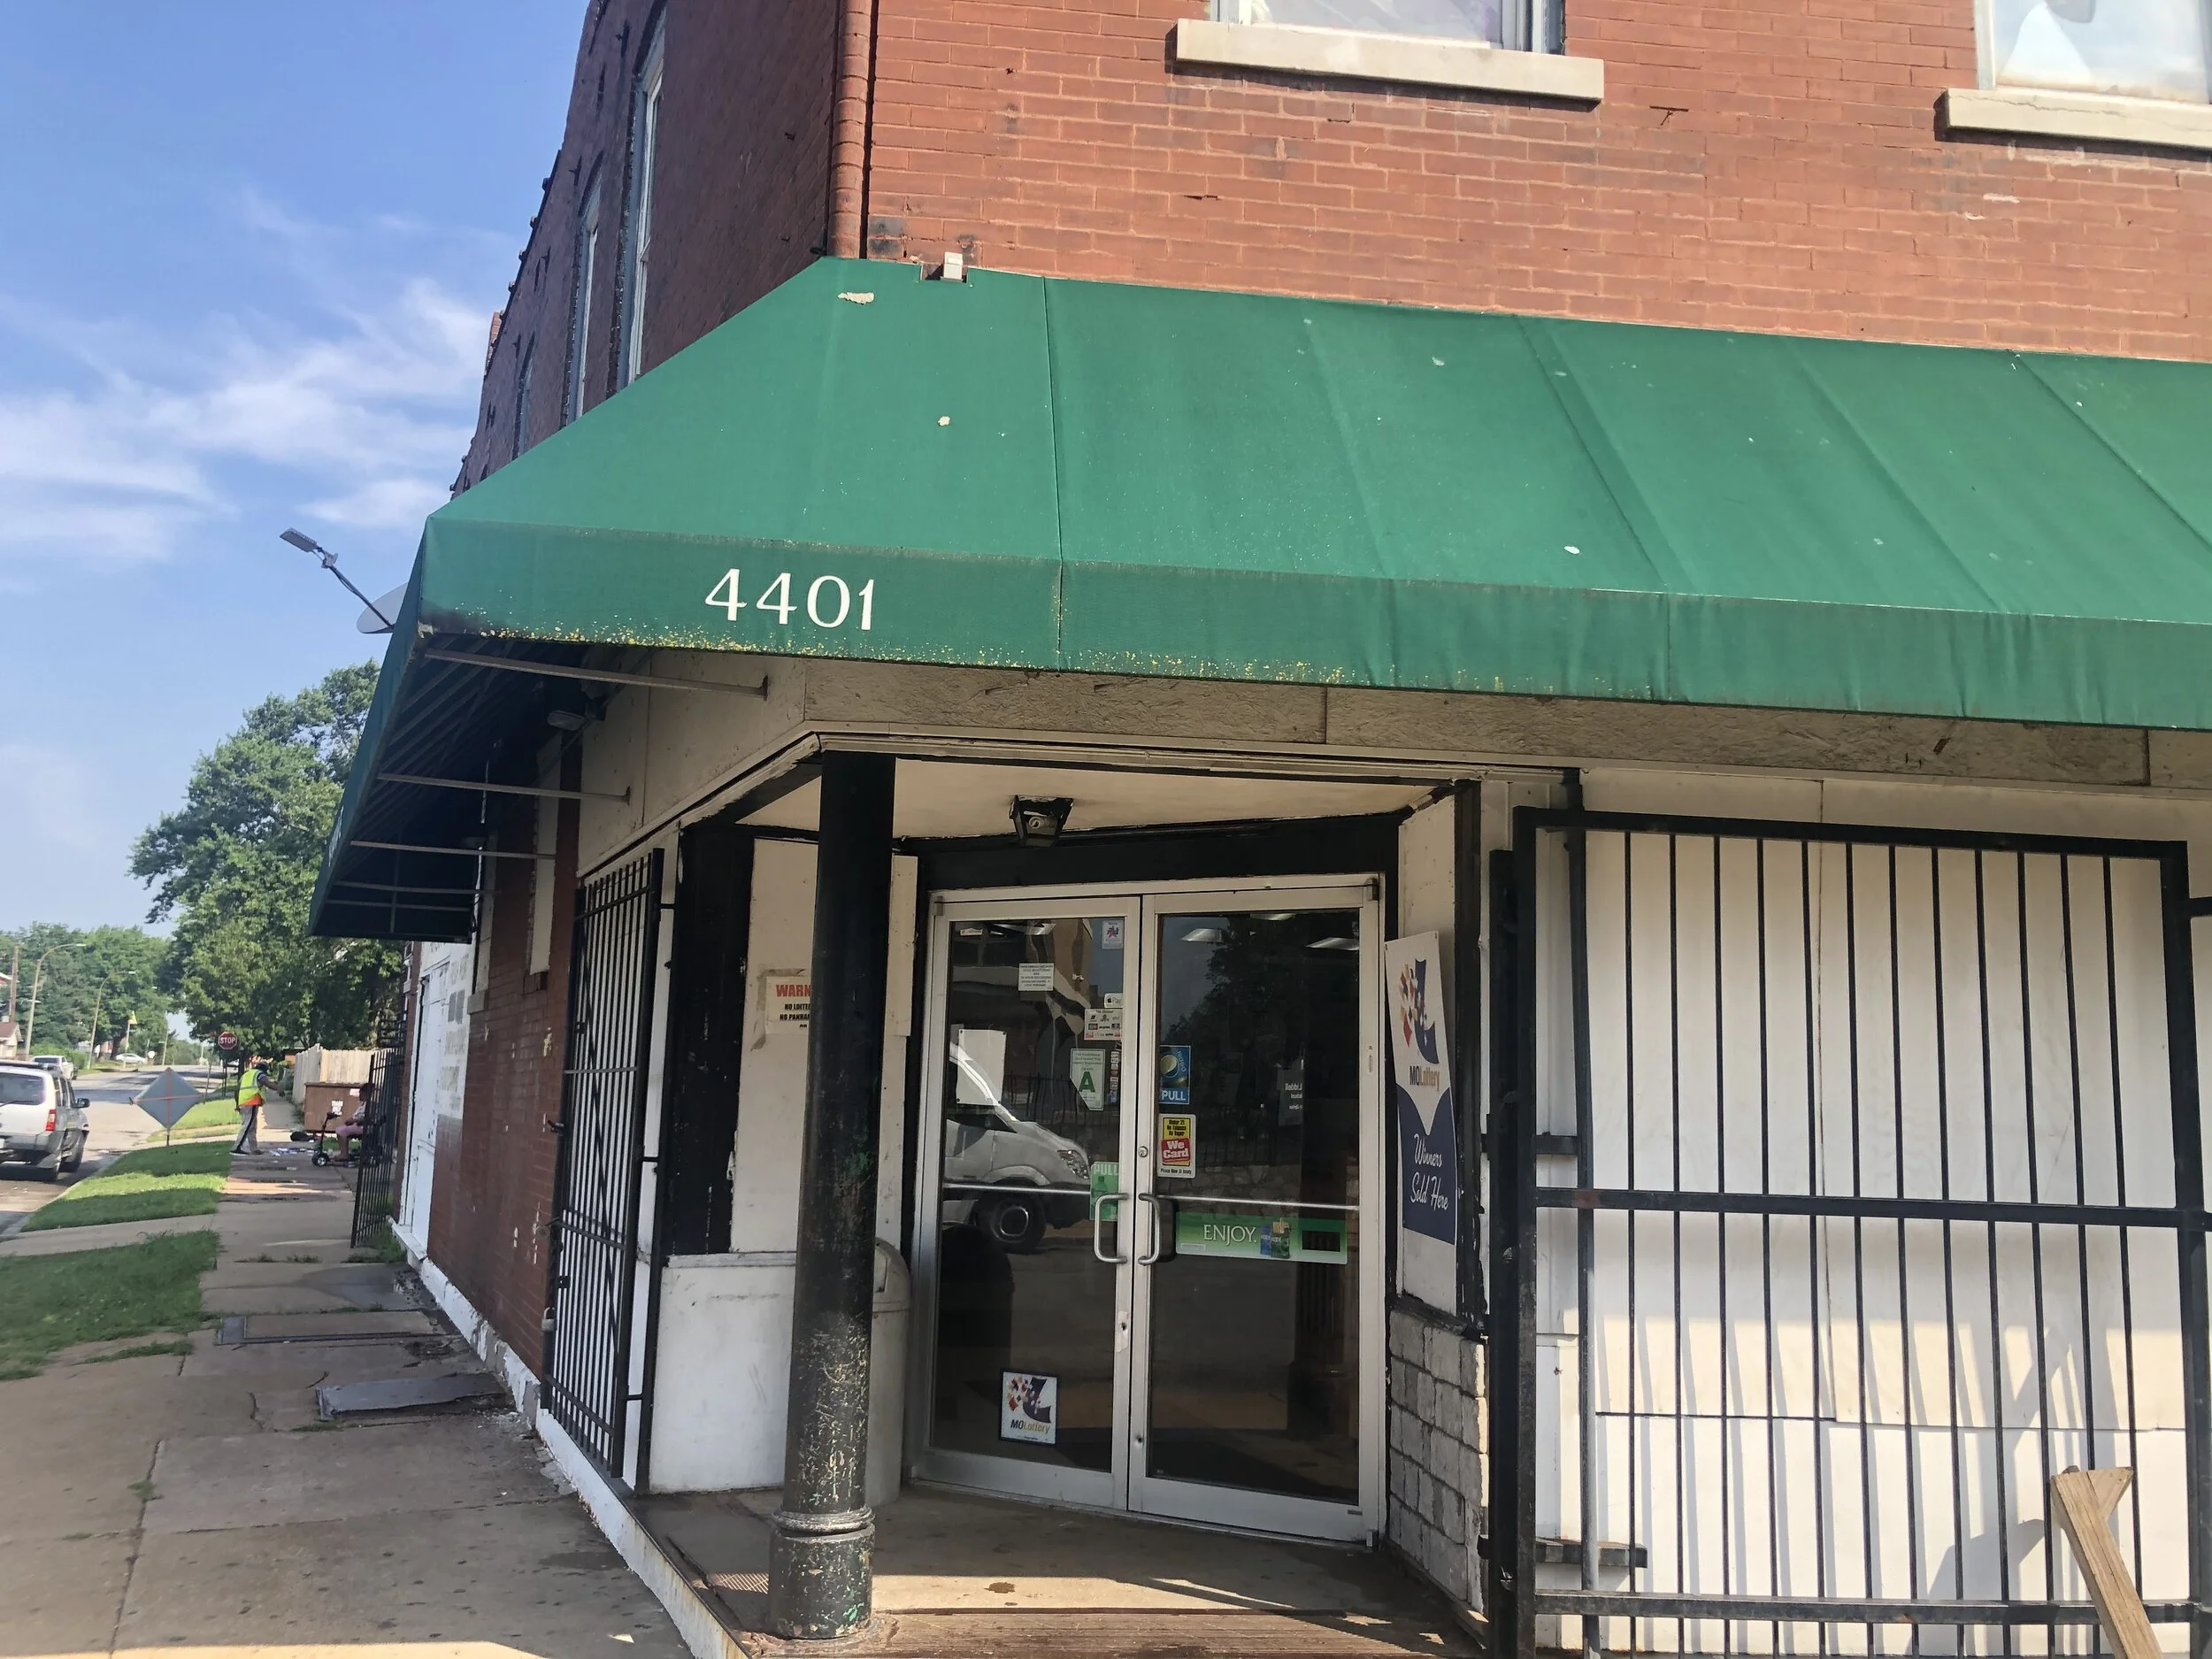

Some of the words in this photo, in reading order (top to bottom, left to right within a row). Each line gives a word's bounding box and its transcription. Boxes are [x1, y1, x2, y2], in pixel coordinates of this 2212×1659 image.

[705, 568, 875, 631] 4401
[1079, 1071, 1096, 1093] A
[1161, 1089, 1187, 1102] PULL
[1166, 1140, 1185, 1150] We
[1413, 1133, 1443, 1168] Winners
[1163, 1148, 1190, 1159] Card
[1093, 1164, 1118, 1176] PULL
[1409, 1171, 1430, 1203] Sold
[1430, 1176, 1448, 1211] Here
[1010, 1419, 1050, 1434] MOLottery
